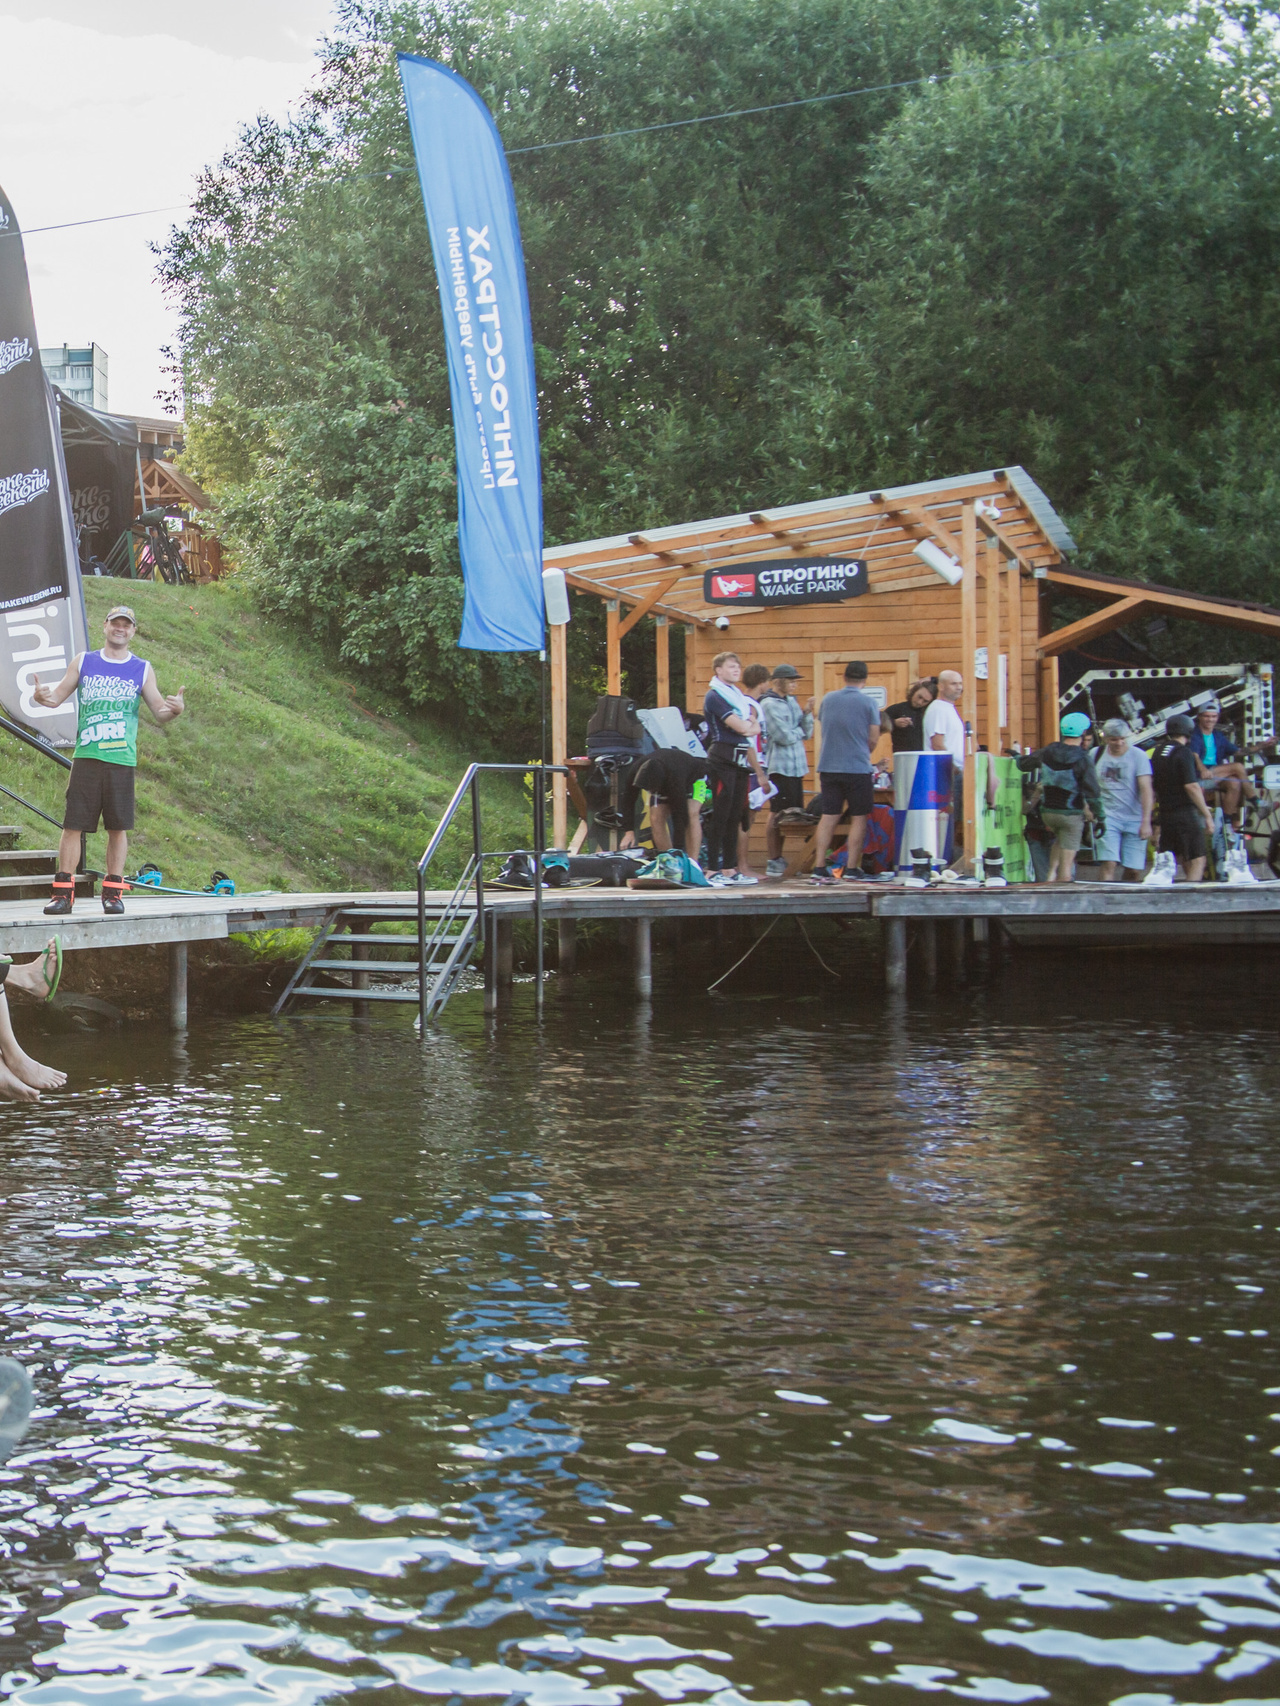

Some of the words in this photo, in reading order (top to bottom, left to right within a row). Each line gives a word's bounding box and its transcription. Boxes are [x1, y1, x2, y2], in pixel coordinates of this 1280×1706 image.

[757, 563, 859, 584] СТРОГИНО
[759, 582, 805, 597] WAKE
[807, 579, 847, 594] PARK
